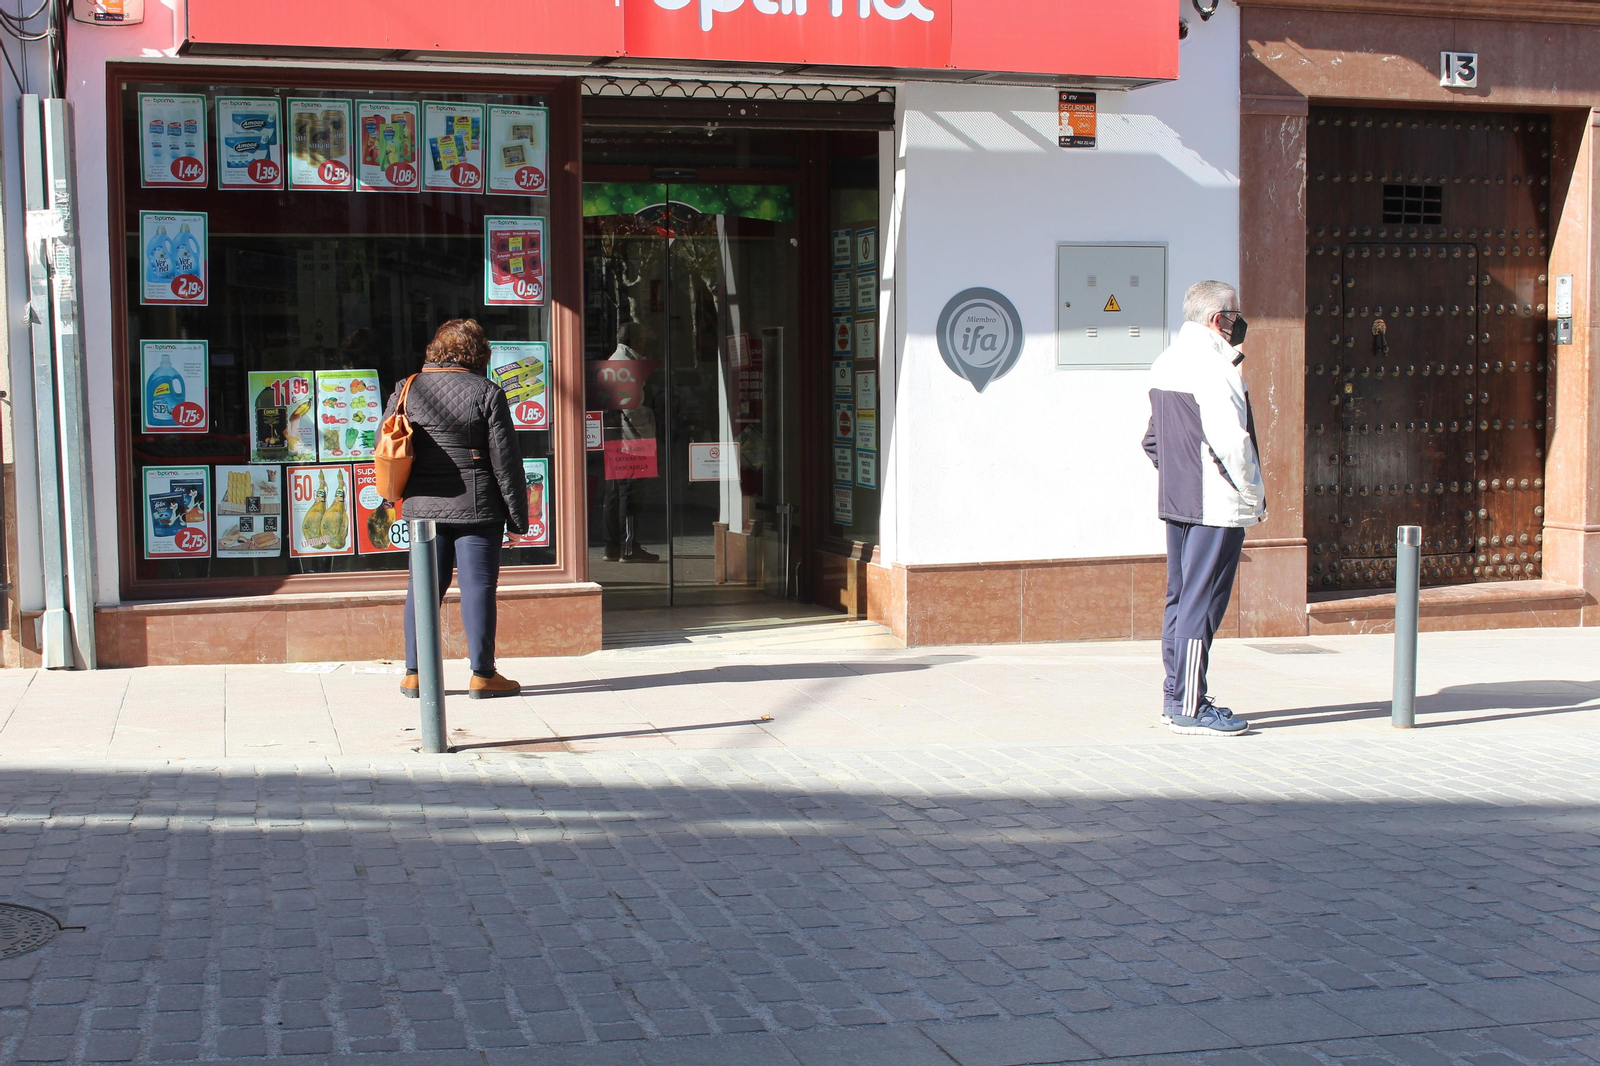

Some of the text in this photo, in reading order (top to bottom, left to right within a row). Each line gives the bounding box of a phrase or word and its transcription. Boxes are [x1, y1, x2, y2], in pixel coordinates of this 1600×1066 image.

[1445, 54, 1476, 81] 13
[1060, 103, 1095, 112] SEGURIDAD
[178, 277, 202, 296] 2,19€
[966, 315, 996, 323] Miembro
[961, 325, 998, 356] ifa
[179, 406, 200, 424] 1,75€
[522, 404, 543, 421] 1,85€
